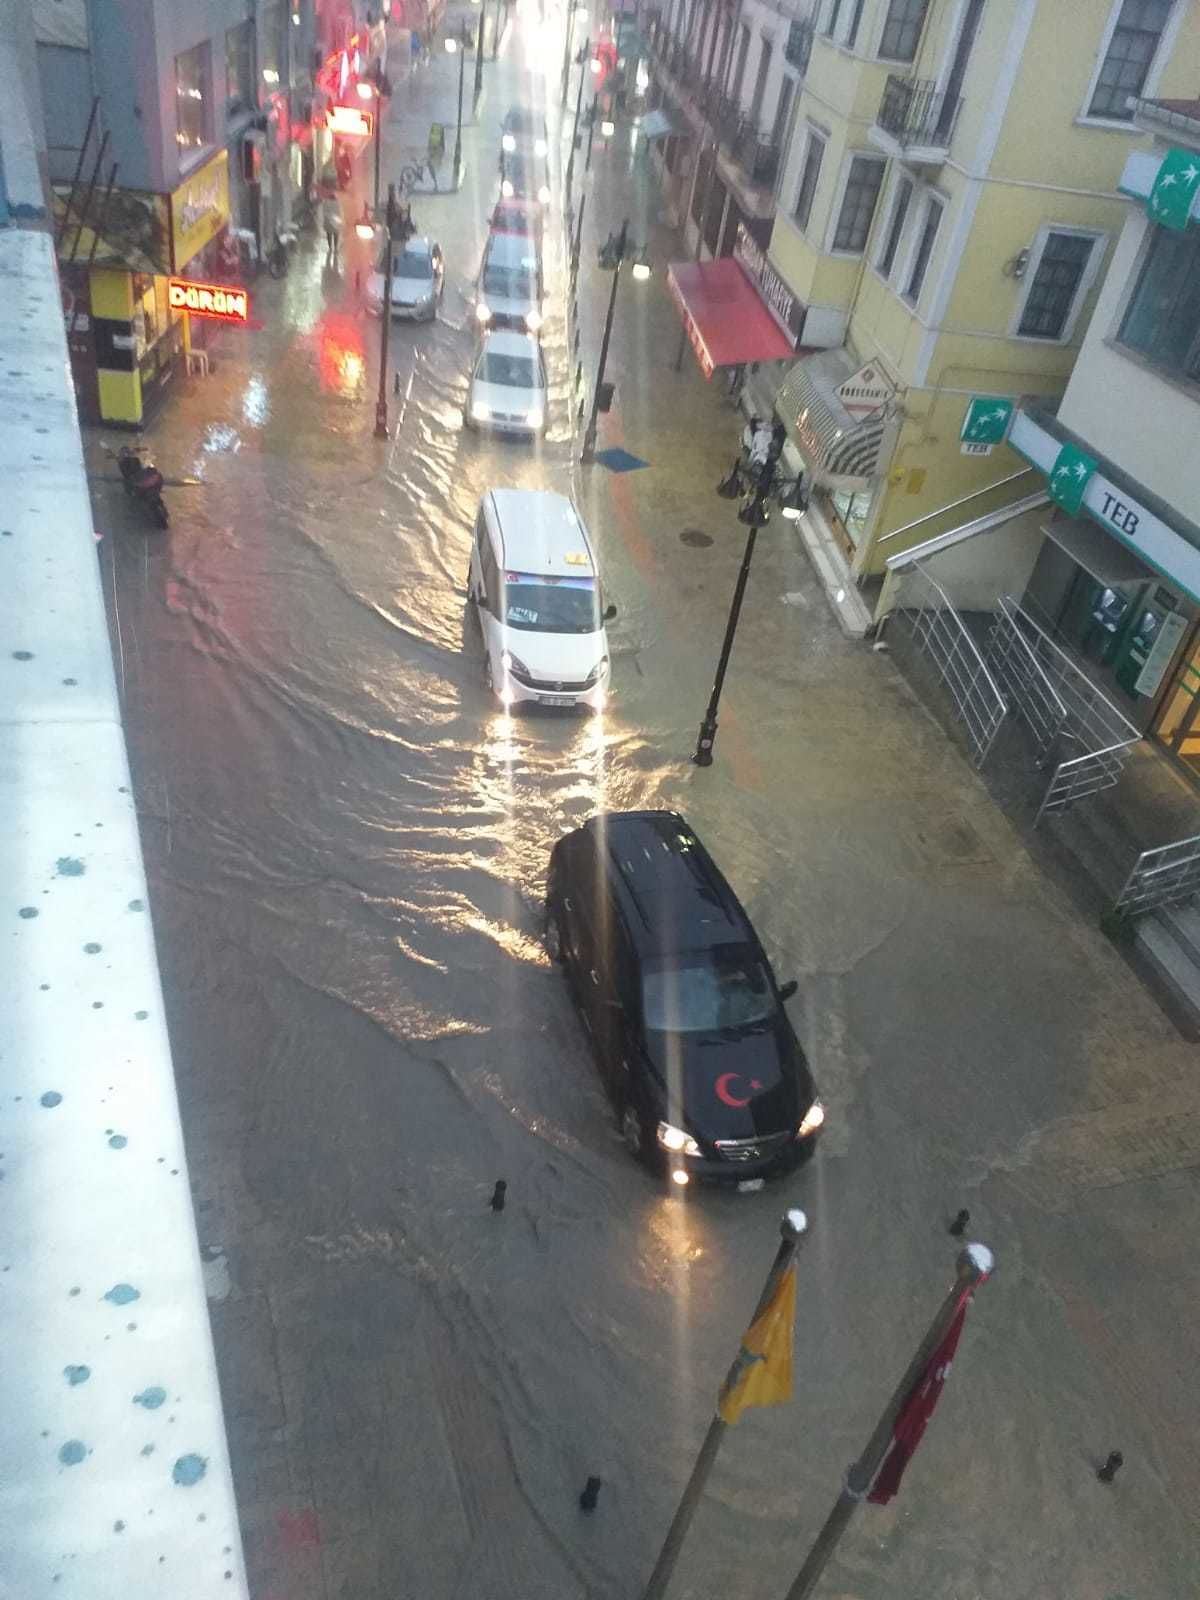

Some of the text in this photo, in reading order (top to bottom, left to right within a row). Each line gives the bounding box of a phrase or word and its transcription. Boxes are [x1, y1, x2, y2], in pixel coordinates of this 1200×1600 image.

[169, 287, 245, 317] DÜRÜM
[967, 443, 989, 454] TEB
[1102, 491, 1140, 536] TEB
